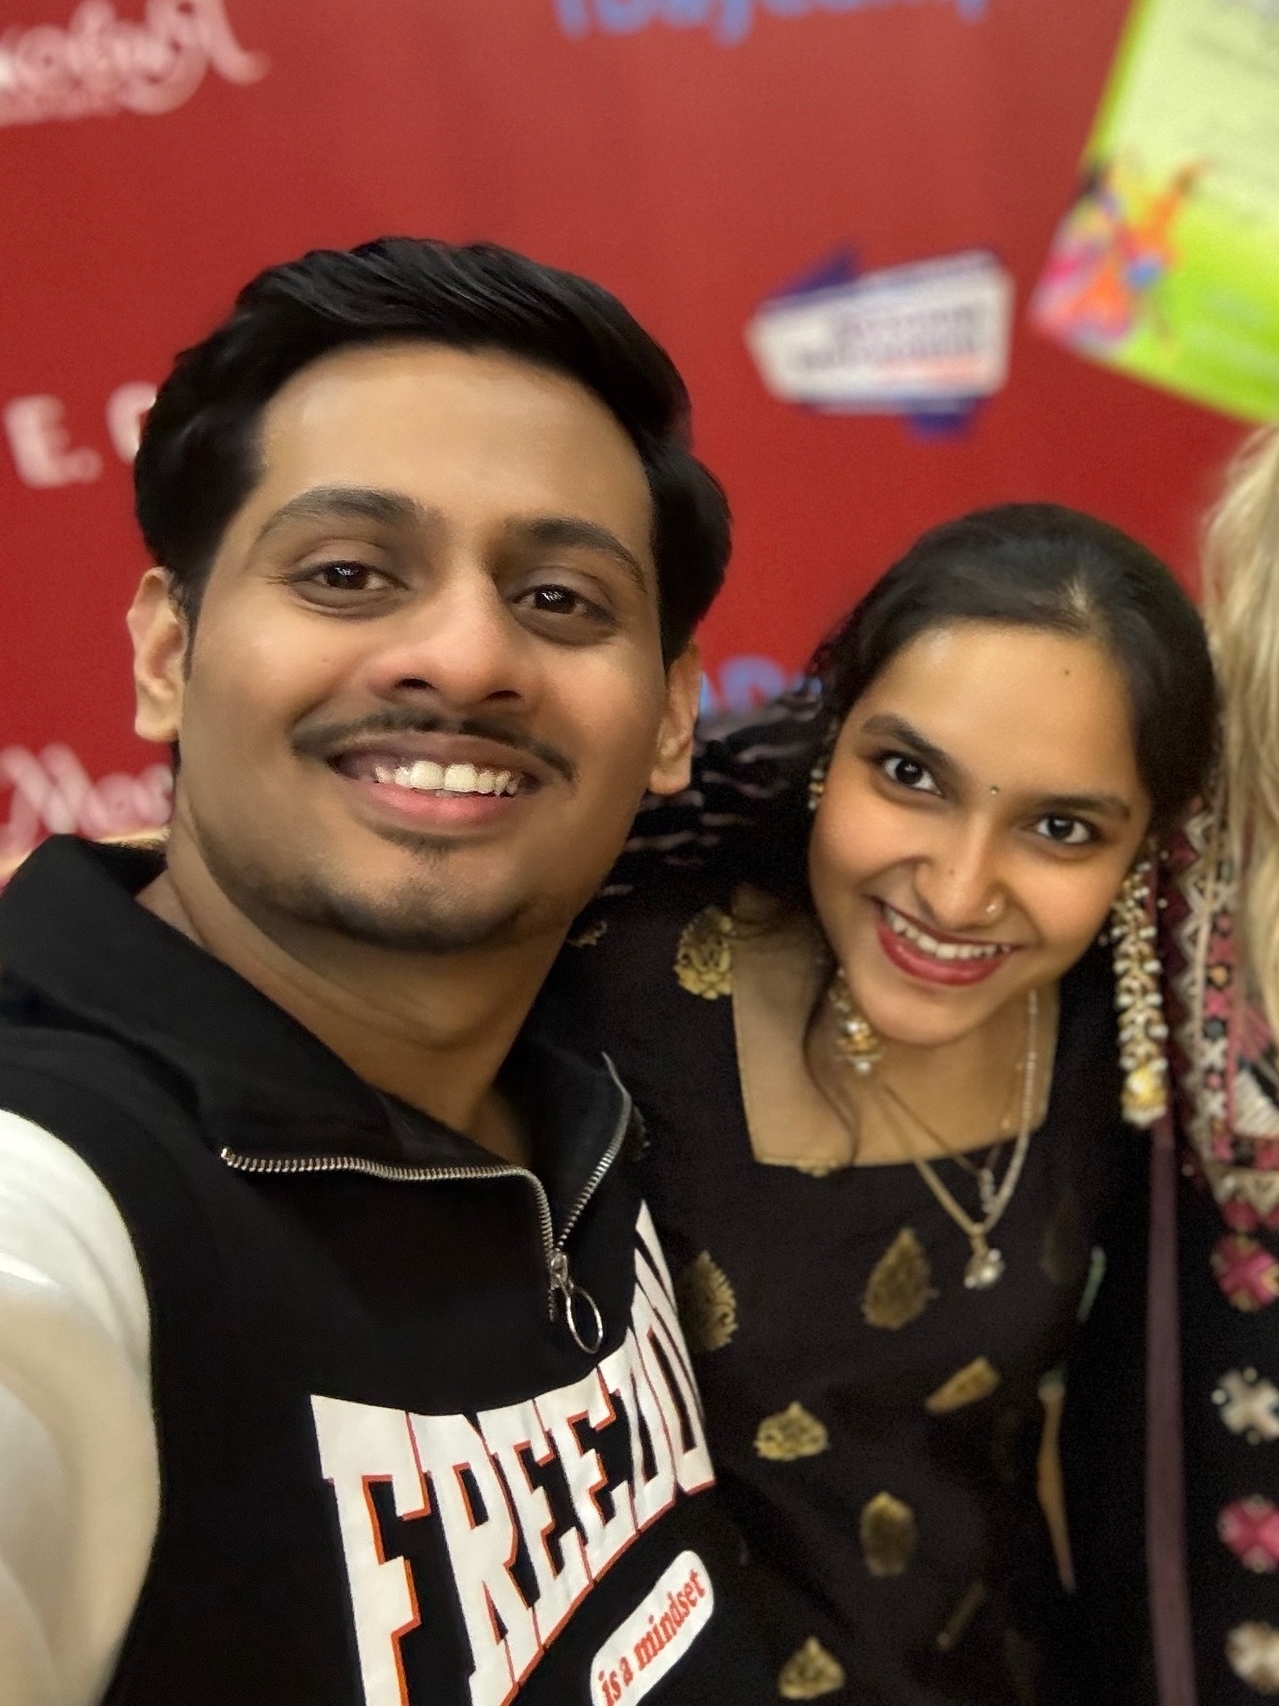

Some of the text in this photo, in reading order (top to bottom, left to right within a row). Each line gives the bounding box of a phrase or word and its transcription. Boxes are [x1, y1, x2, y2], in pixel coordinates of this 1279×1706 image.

[598, 1568, 705, 1706] is a mindset
